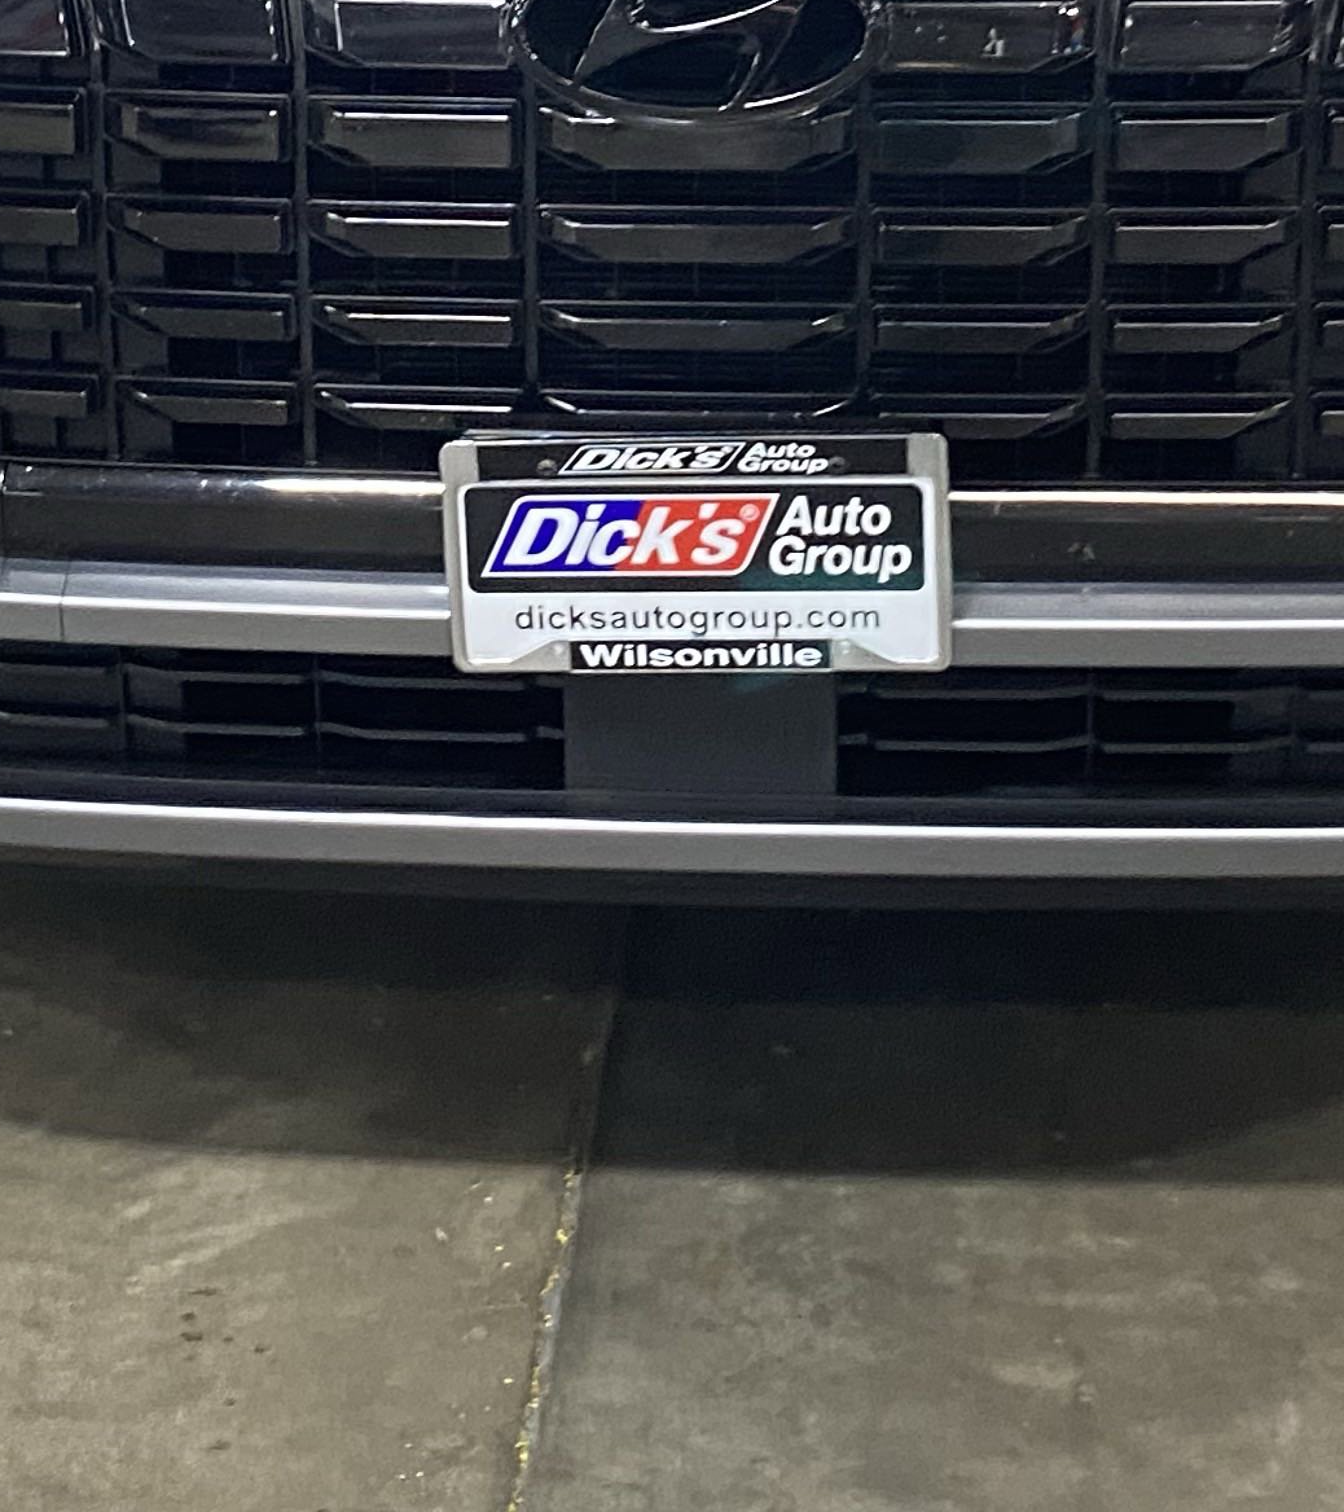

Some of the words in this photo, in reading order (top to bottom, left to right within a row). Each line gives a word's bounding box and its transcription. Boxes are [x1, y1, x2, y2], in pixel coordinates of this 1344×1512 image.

[571, 444, 726, 471] Dick's
[743, 441, 816, 459] Auto
[736, 456, 829, 475] Group
[775, 494, 892, 537] Auto
[502, 502, 746, 566] Dick's
[767, 534, 913, 584] Group
[514, 605, 881, 638] dicksautogroup.com
[579, 641, 824, 669] Wilsonville
